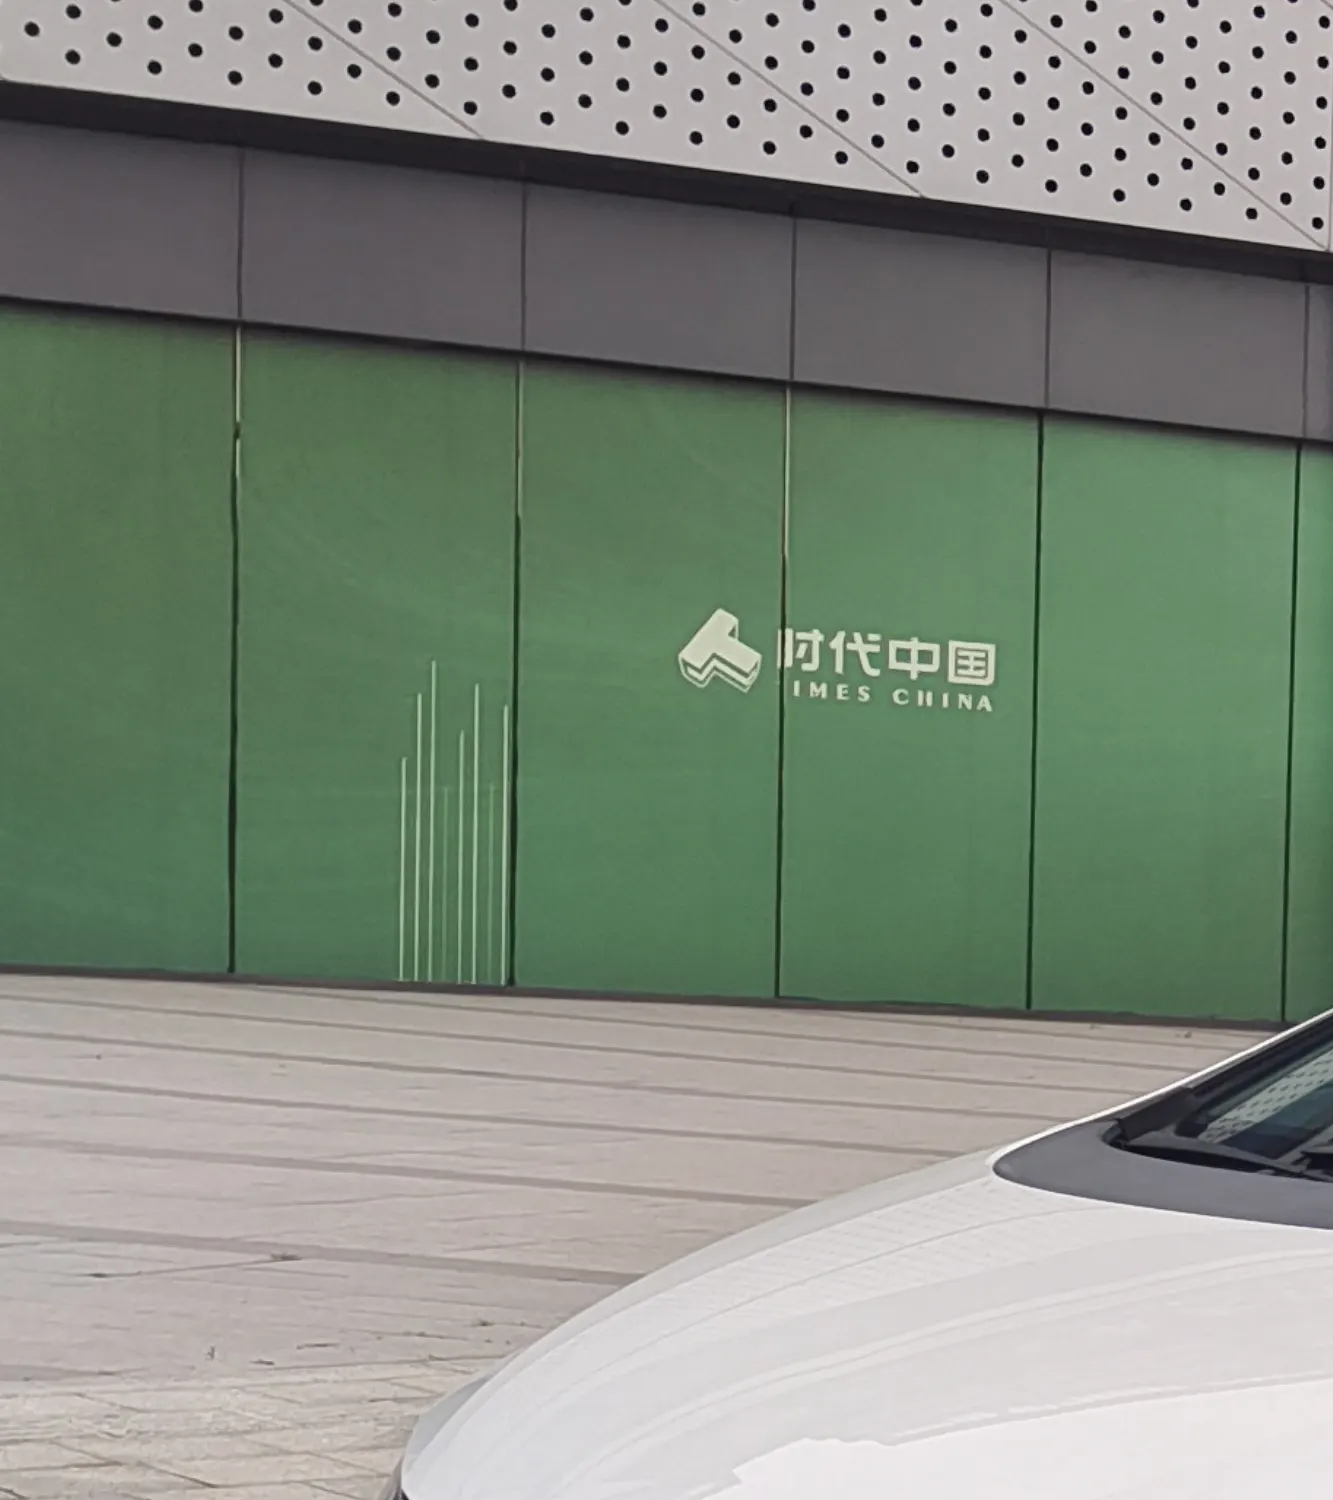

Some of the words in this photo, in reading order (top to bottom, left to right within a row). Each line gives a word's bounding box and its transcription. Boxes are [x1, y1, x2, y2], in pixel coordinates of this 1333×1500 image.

[776, 627, 996, 686] 时代中国
[776, 680, 871, 702] IMES
[892, 688, 993, 712] CHINA
